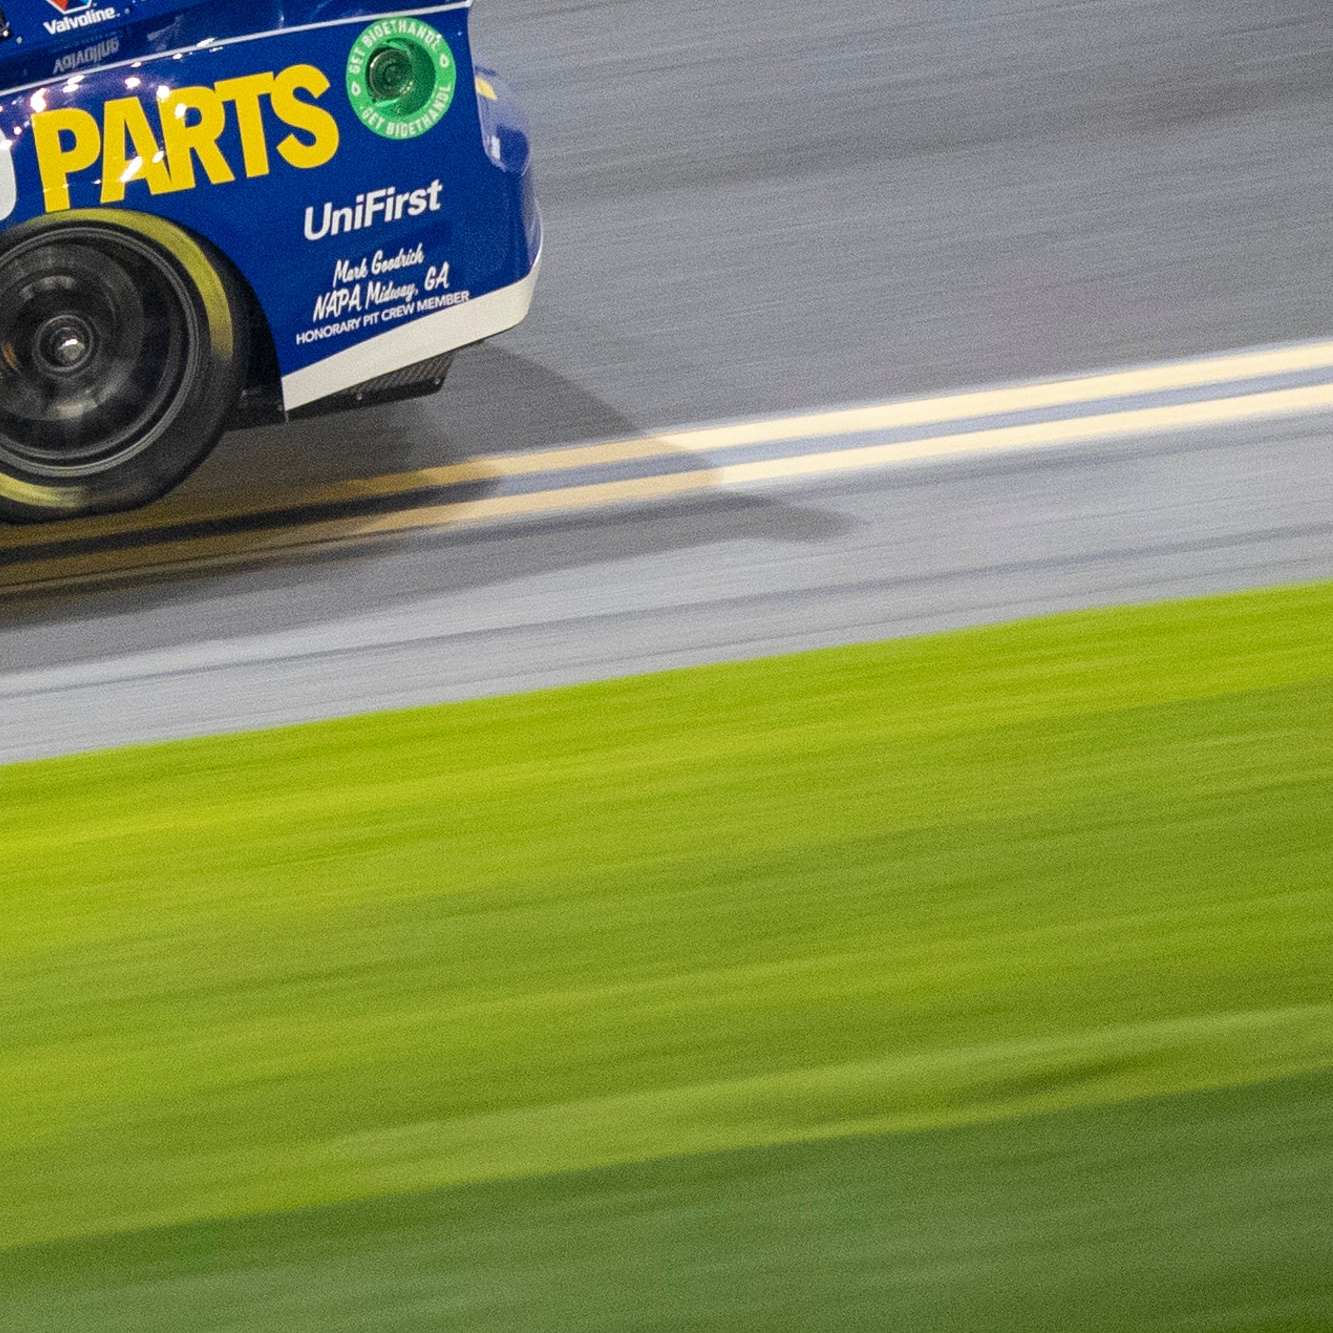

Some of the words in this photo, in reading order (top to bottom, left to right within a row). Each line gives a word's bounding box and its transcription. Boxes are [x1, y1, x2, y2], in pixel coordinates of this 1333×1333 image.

[42, 7, 117, 35] Valvoline
[349, 47, 366, 74] GET
[362, 19, 440, 53] BIOETHANOL
[361, 107, 385, 130] GET
[386, 83, 452, 138] BIOETHANOL
[30, 64, 340, 213] PARTS
[304, 179, 443, 241] UniFirst
[313, 283, 362, 323] NAPA
[424, 261, 450, 291] GA
[333, 258, 368, 287] Mark
[371, 243, 424, 275] Goodrich
[296, 317, 361, 345] HONORARY
[363, 312, 381, 326] PIT
[381, 303, 415, 321] CREW
[416, 290, 470, 312] MEMBER
